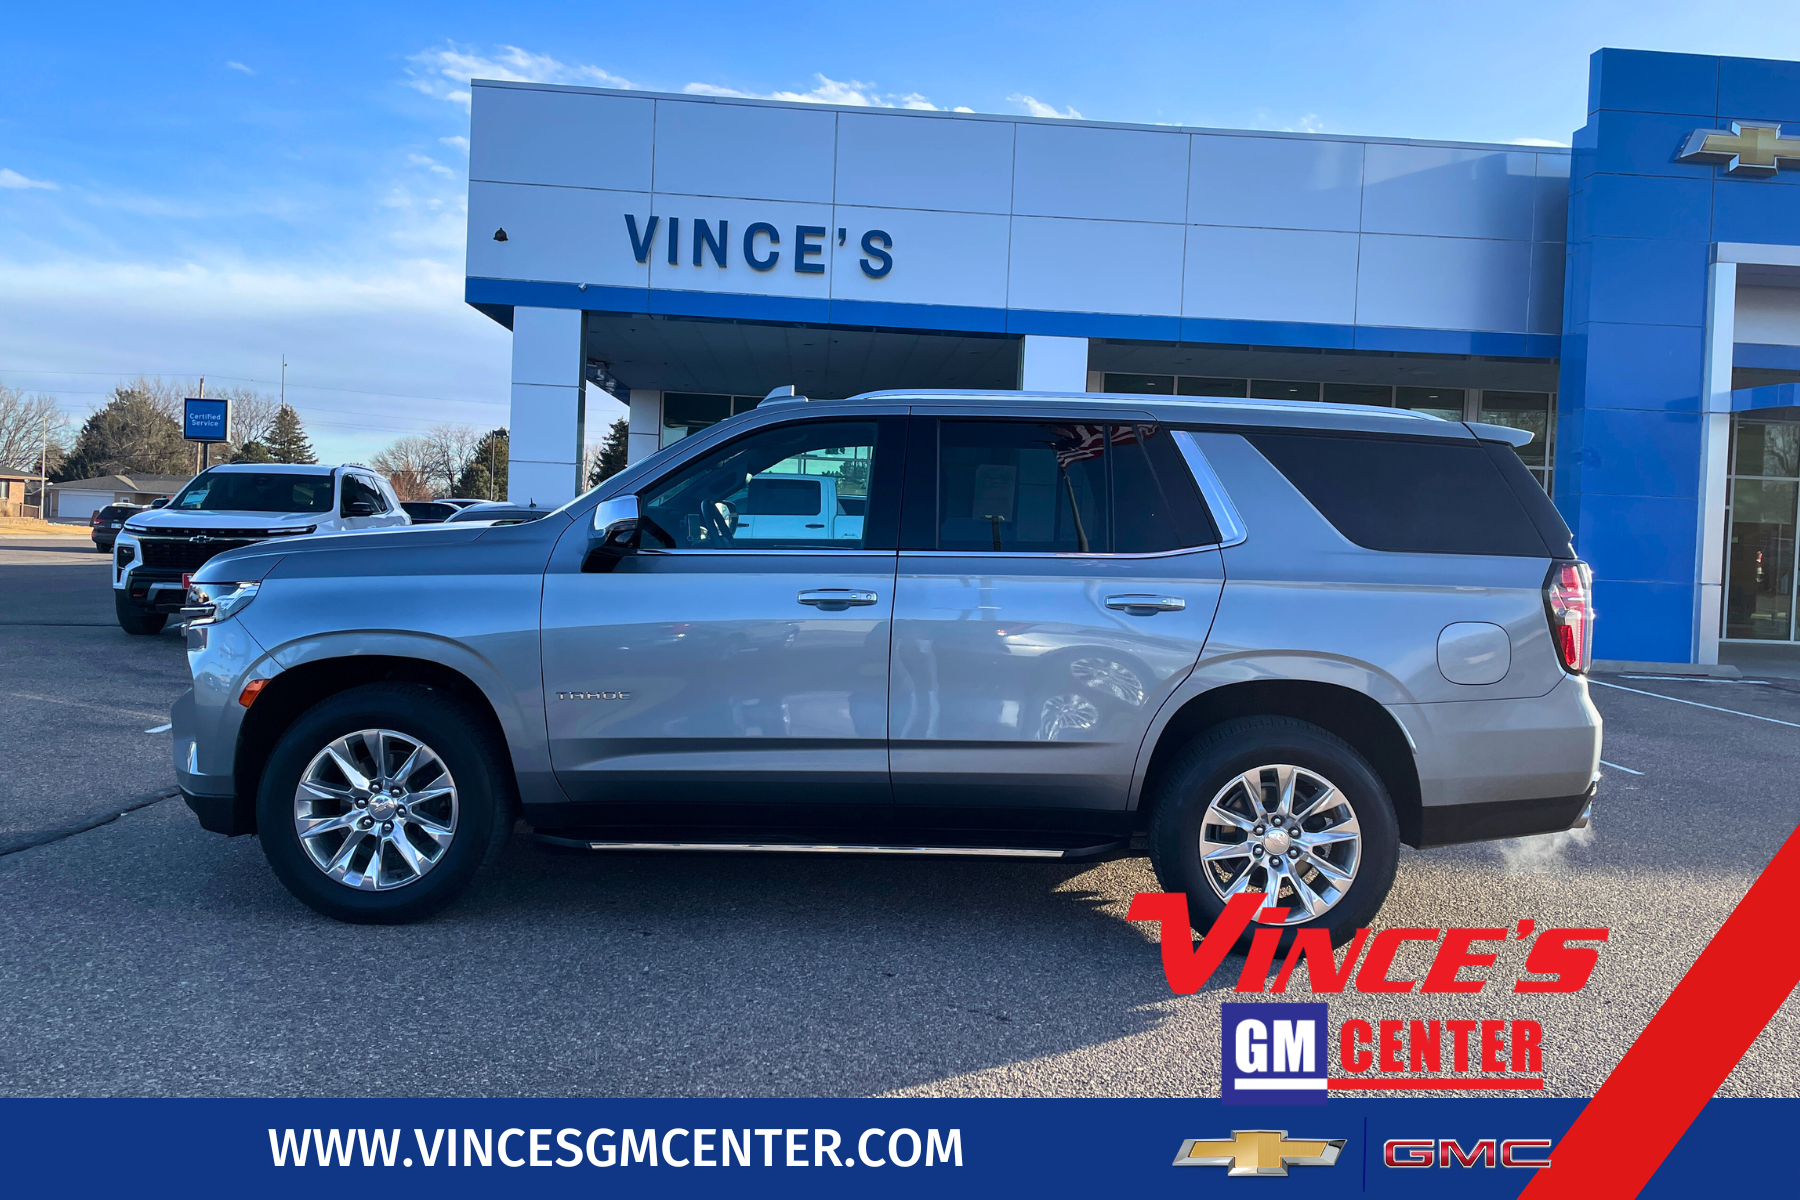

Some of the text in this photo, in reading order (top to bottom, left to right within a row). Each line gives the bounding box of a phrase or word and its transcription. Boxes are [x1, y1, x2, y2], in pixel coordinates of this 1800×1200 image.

[624, 213, 893, 279] VINCE'S
[189, 412, 221, 420] Certified
[191, 419, 219, 427] Service
[555, 691, 632, 700] TAHOE
